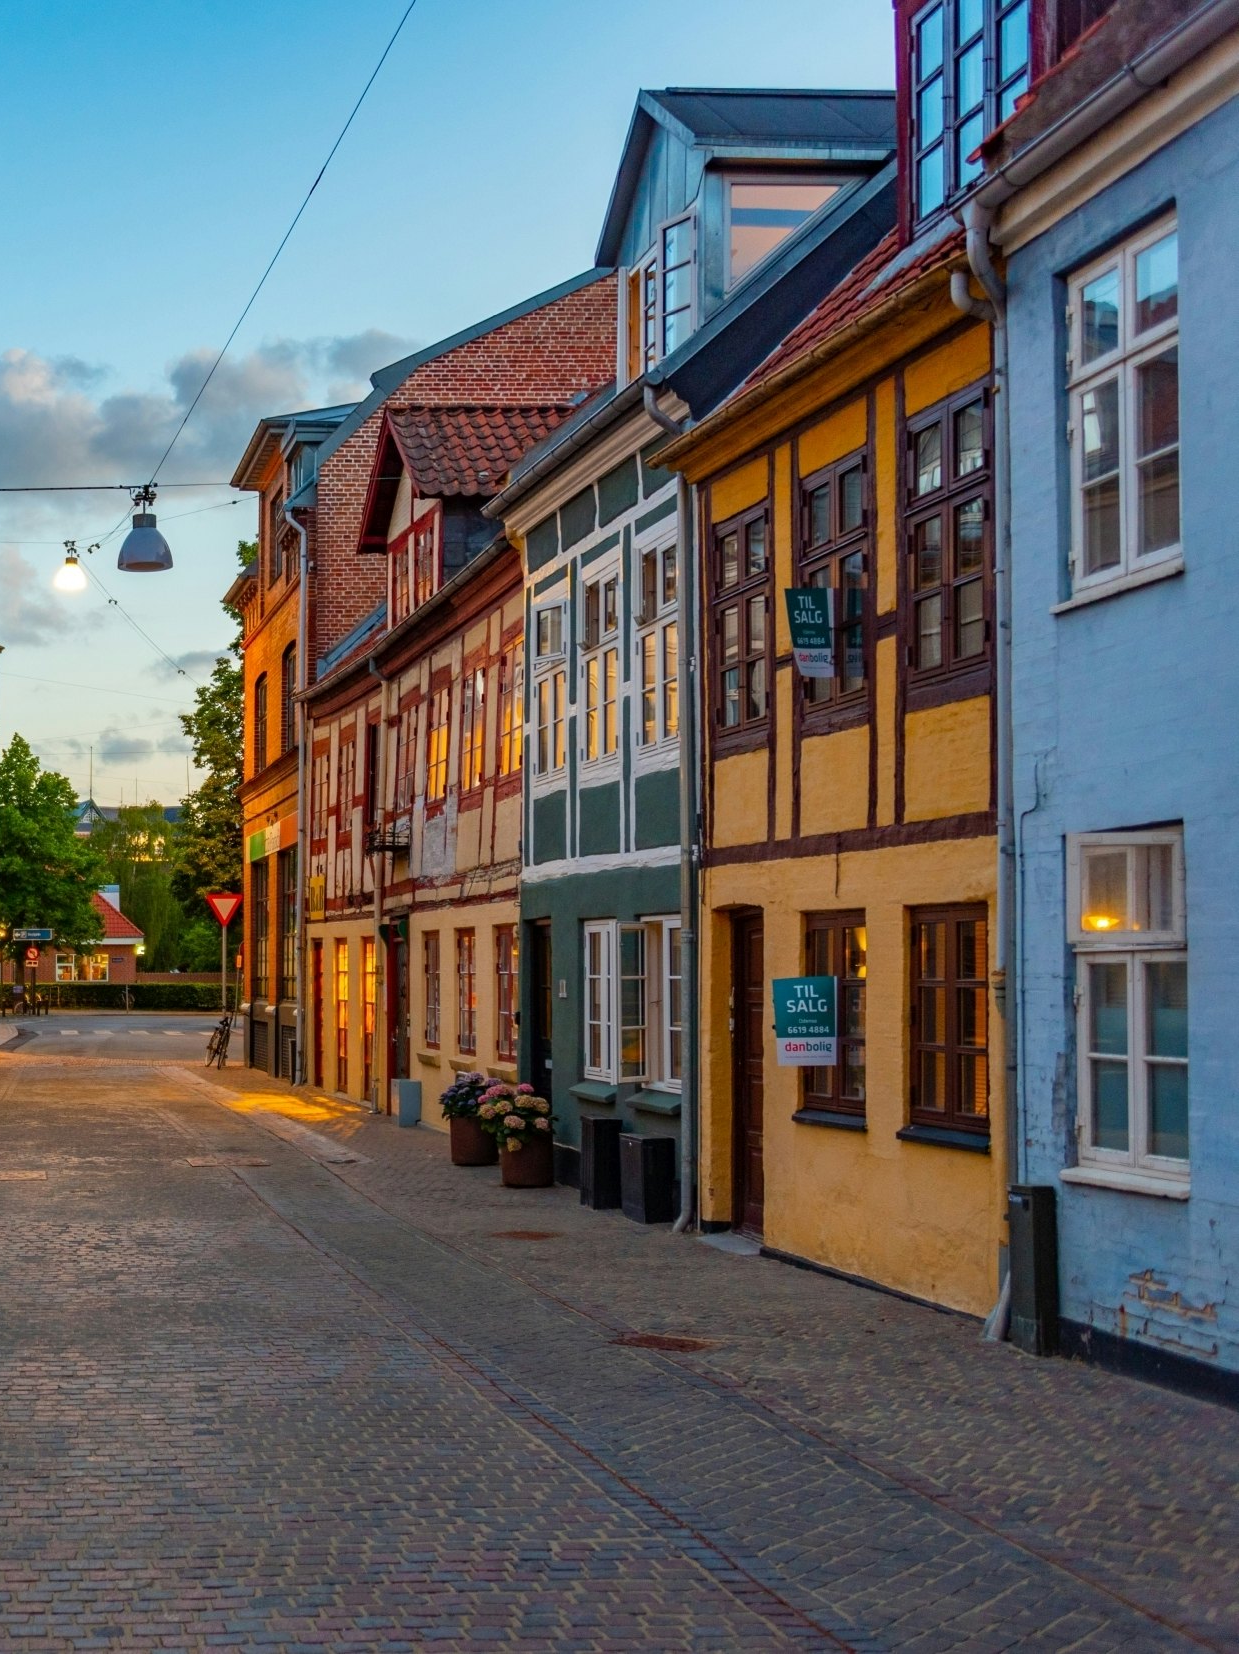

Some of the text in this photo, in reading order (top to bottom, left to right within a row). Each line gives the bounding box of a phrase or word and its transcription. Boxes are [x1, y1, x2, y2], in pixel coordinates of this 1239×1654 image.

[797, 596, 815, 608] TIL
[794, 611, 822, 623] SALG
[793, 985, 819, 998] TIL
[786, 999, 828, 1013] SALG
[787, 1026, 830, 1034] 6619 4884
[785, 1042, 832, 1052] danbolig
